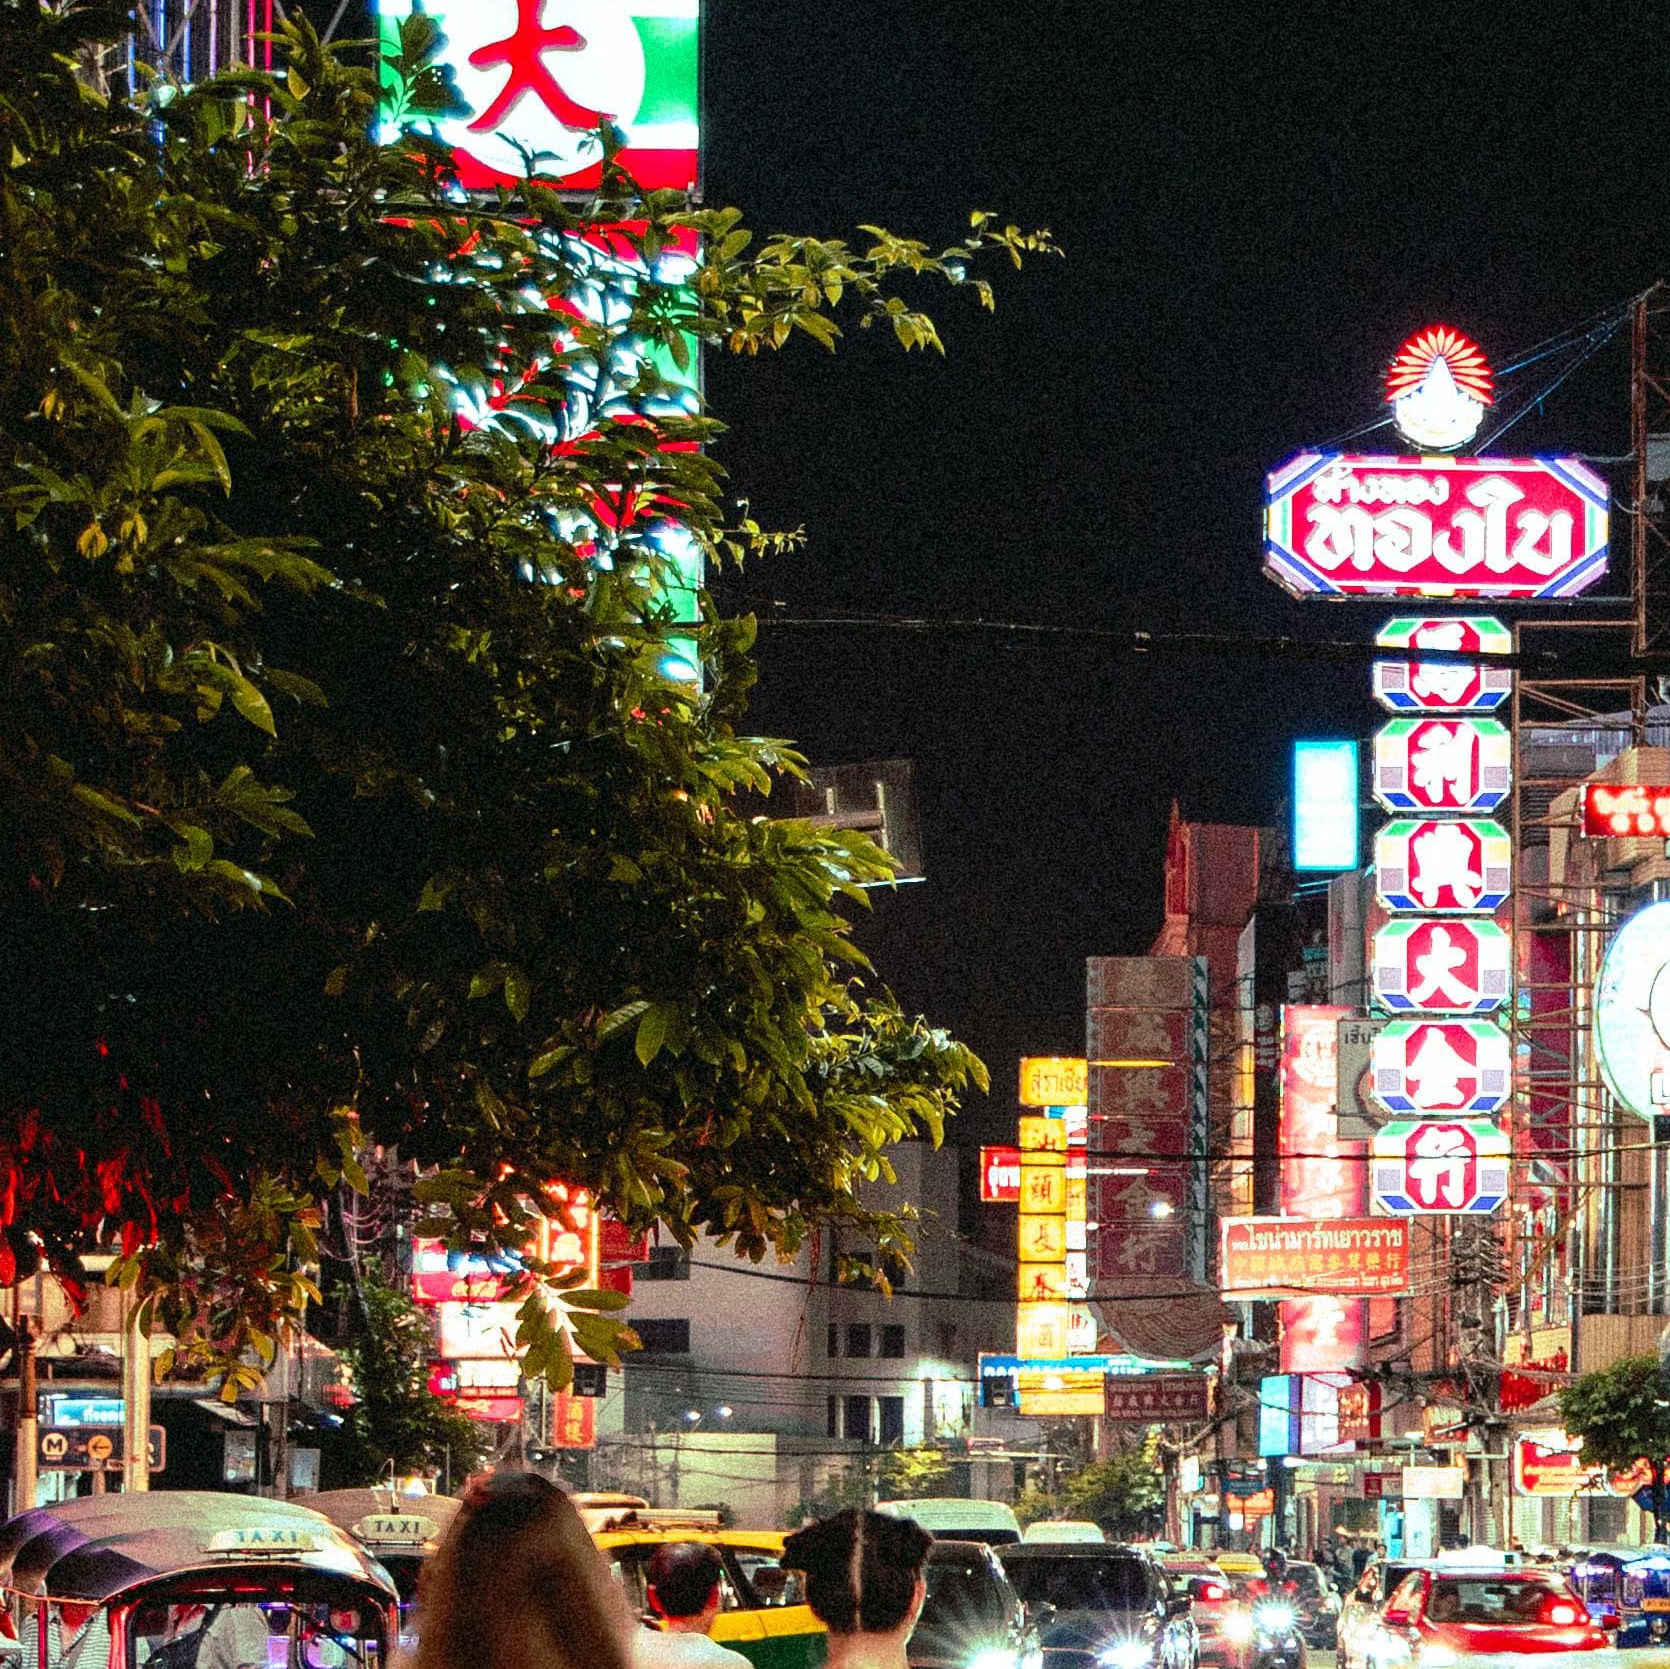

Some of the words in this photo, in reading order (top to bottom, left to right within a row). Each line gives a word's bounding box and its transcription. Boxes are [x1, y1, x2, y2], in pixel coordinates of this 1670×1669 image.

[46, 1438, 63, 1452] M
[374, 1520, 421, 1534] TAXI
[235, 1529, 299, 1544] TAXI
